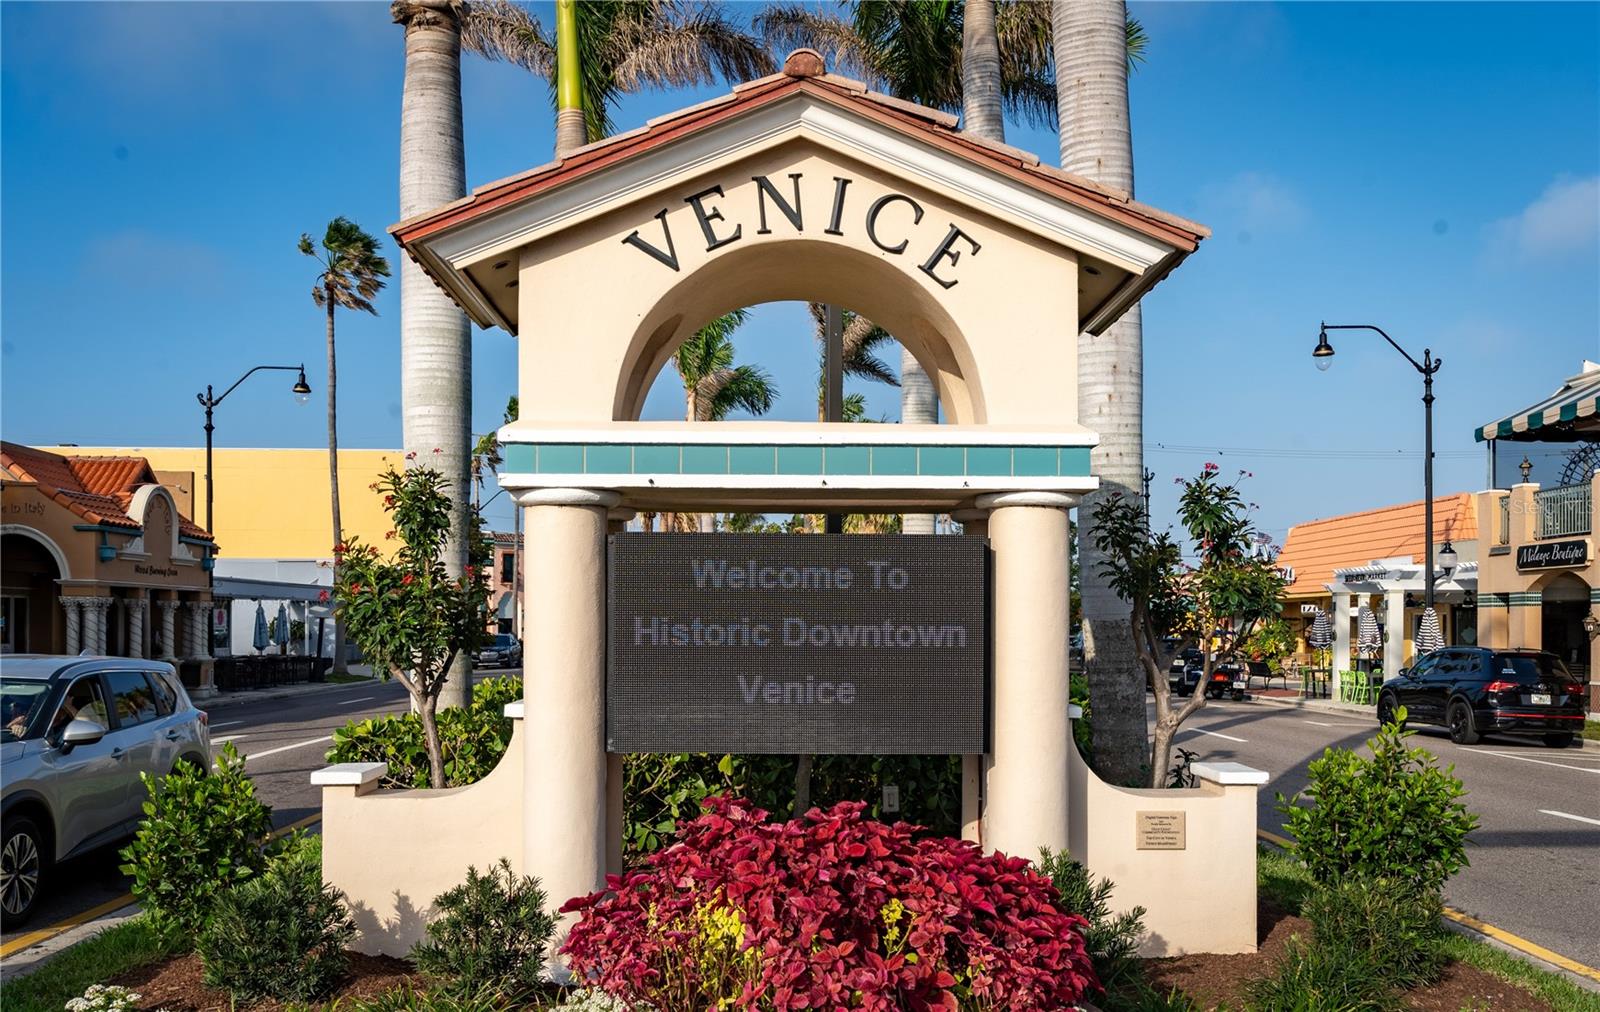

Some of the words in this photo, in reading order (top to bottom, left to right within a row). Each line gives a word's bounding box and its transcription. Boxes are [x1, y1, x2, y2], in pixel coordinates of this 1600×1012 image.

[621, 172, 982, 290] VENICE
[1551, 544, 1584, 564] Boutique
[691, 558, 853, 590] Welcome
[867, 560, 910, 590] To
[632, 616, 771, 647] Historic
[782, 617, 967, 648] Downtown
[737, 674, 857, 704] Venice
